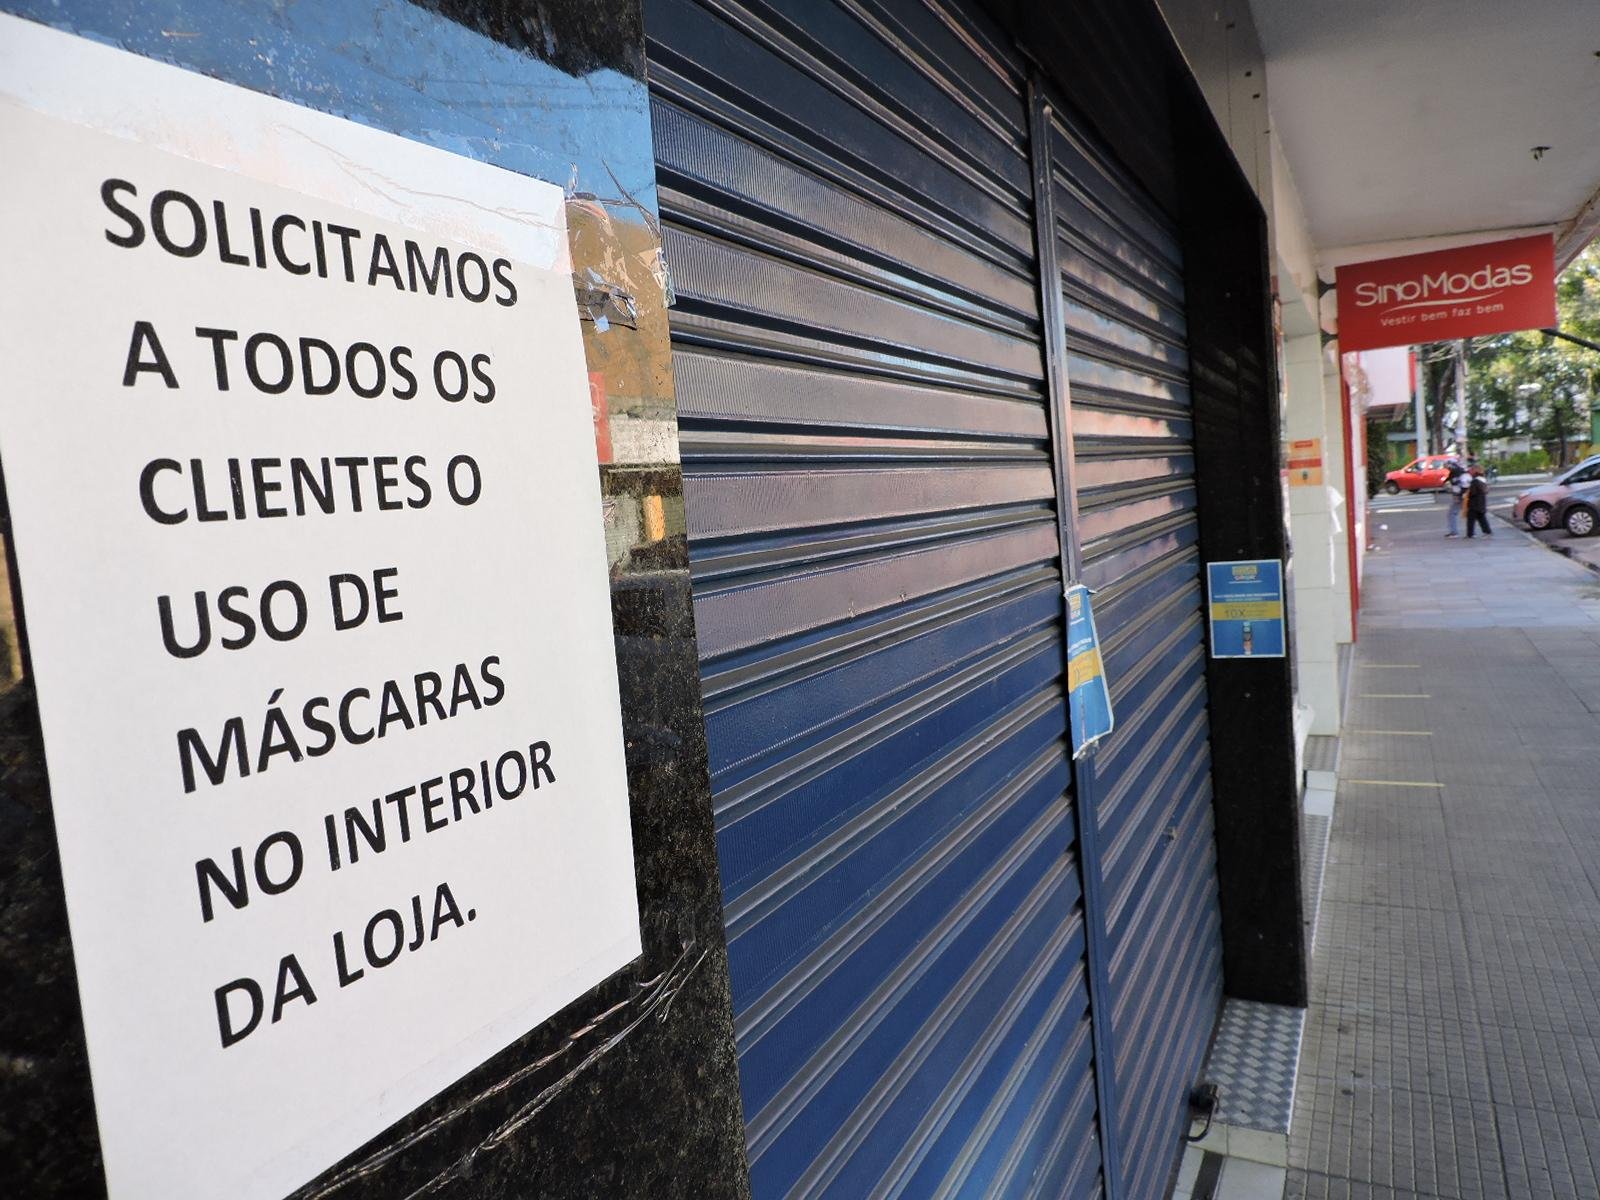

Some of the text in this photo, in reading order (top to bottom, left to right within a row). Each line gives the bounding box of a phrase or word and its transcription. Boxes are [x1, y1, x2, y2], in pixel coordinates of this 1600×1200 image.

[101, 178, 518, 307] SOLICITAMOS
[122, 320, 496, 404] A TODOS OS
[1421, 310, 1448, 322] bem
[1452, 306, 1471, 318] faz
[1476, 302, 1504, 315] bem
[139, 454, 482, 525] CLIENTES O
[157, 567, 403, 659] USO DE
[176, 655, 505, 794] MÁSCARAS
[195, 740, 556, 923] NO INTERIOR
[214, 882, 477, 1049] DA LOJA.
